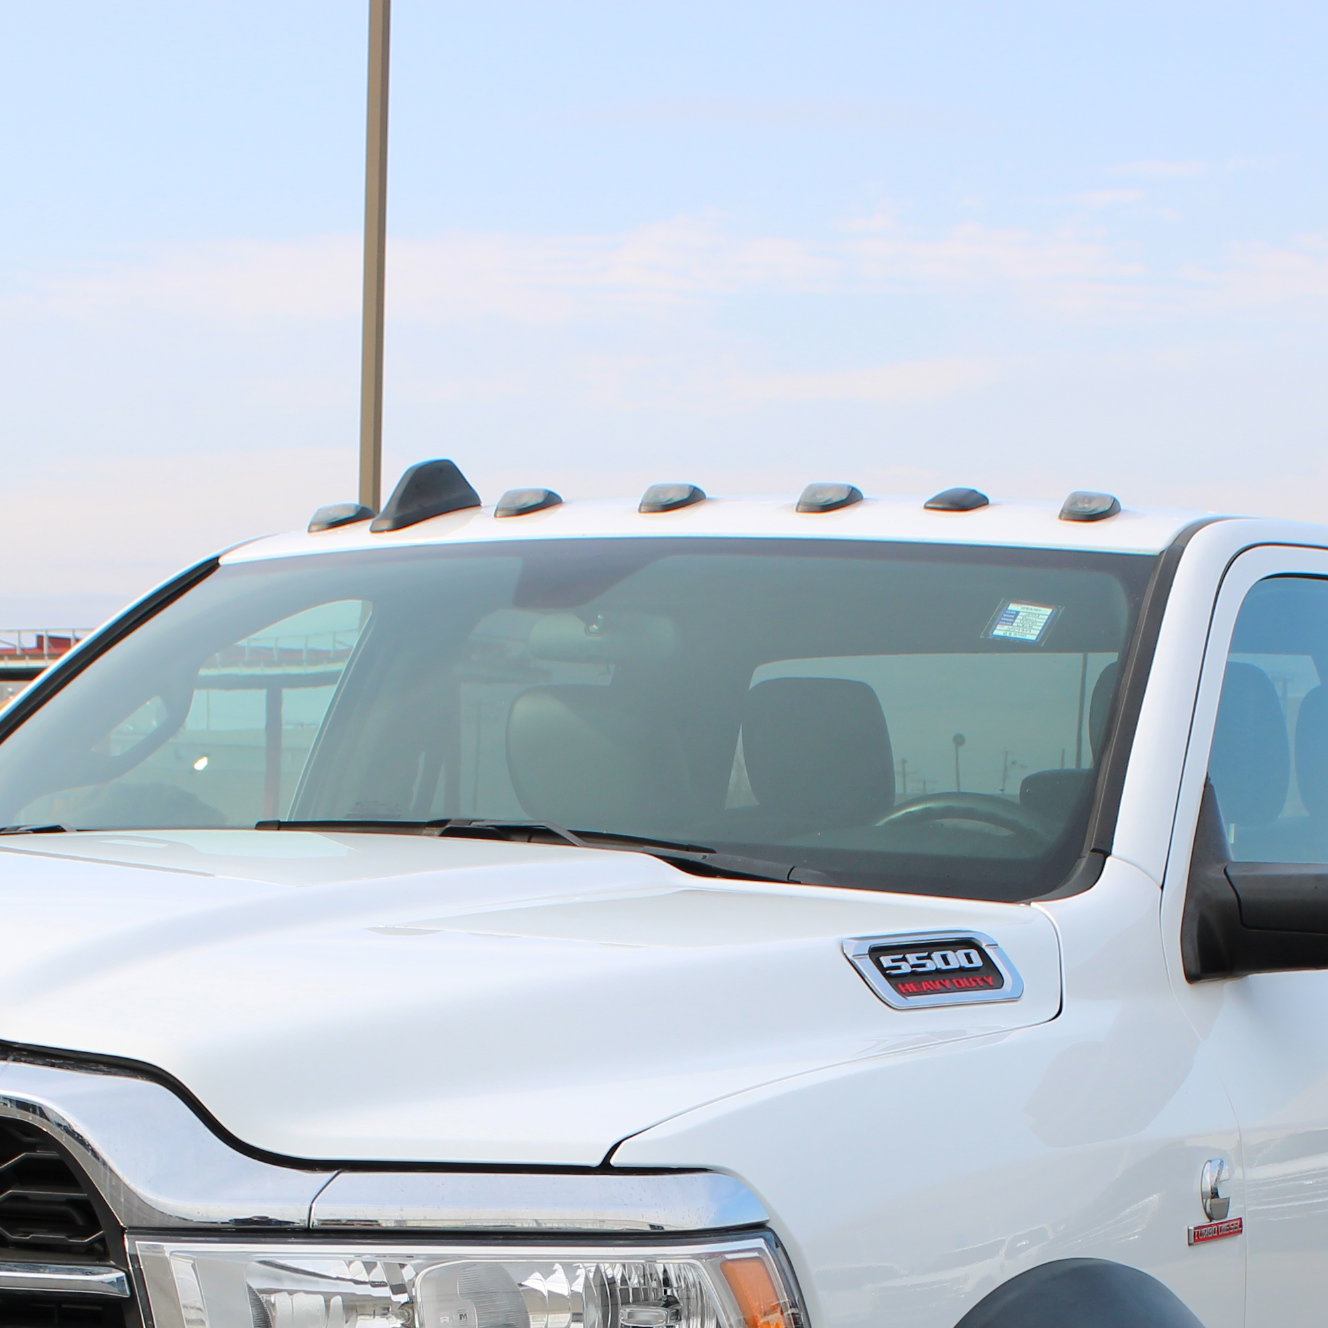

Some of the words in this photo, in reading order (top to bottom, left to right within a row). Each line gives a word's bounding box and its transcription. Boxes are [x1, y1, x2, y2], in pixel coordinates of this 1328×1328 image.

[879, 949, 984, 975] 5500
[896, 979, 953, 993] HEAVY
[952, 976, 996, 989] DUTY
[1194, 1226, 1218, 1240] TURBO
[1218, 1220, 1242, 1236] DIESEL
